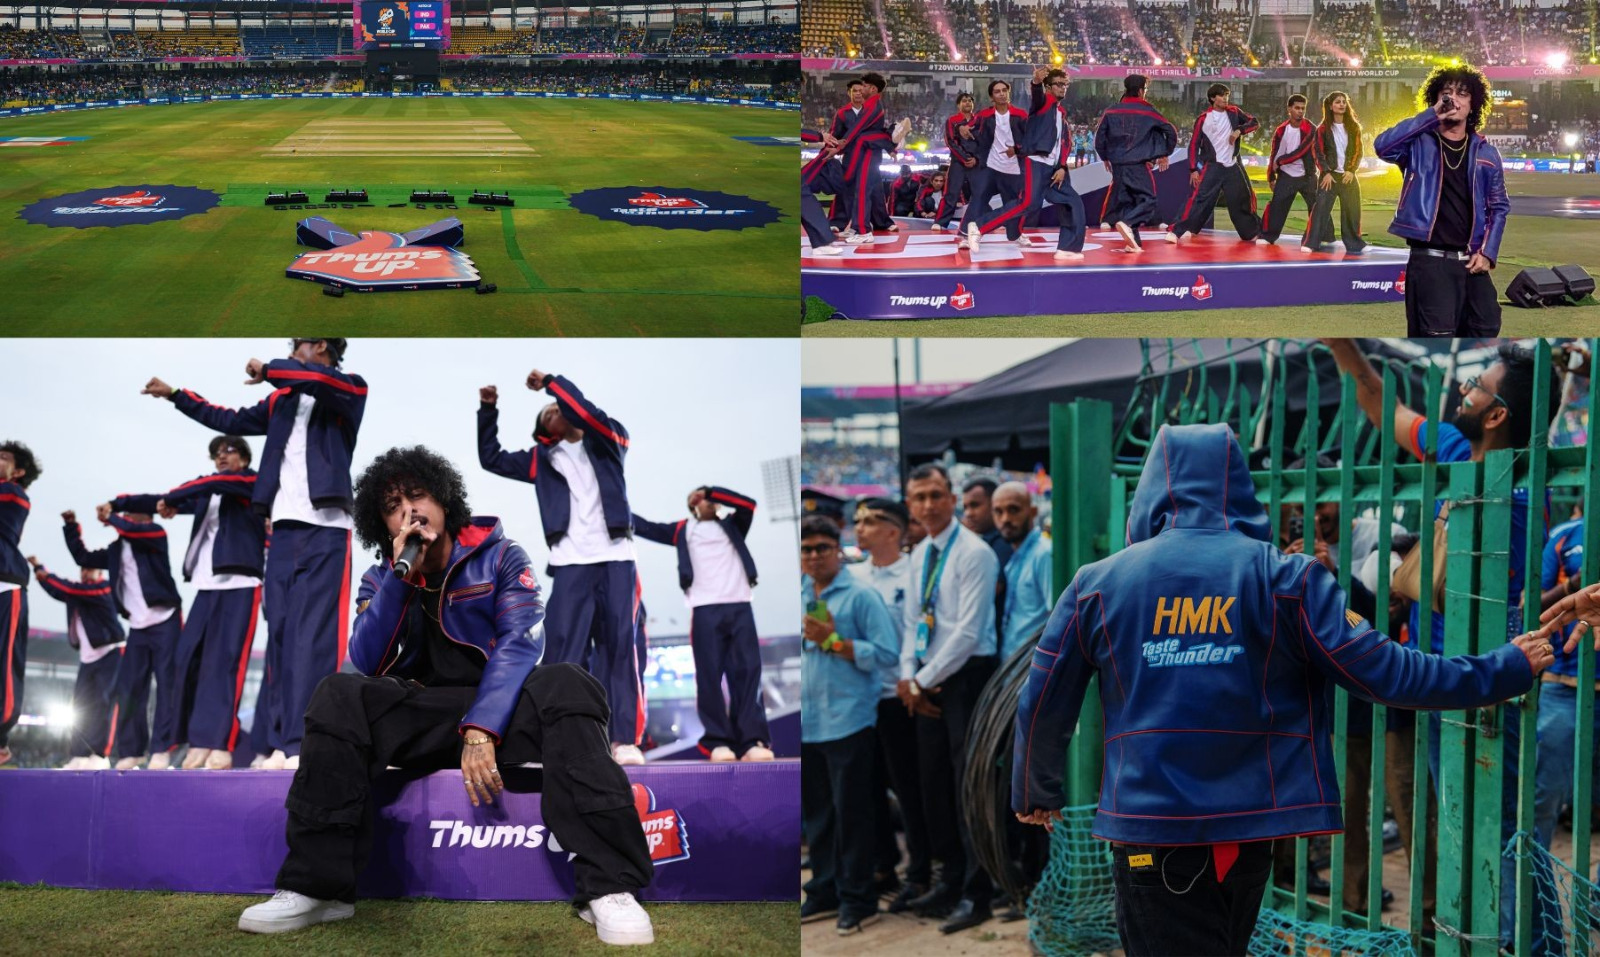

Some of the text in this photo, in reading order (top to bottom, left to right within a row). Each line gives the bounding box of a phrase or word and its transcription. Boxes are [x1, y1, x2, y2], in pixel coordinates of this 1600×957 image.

[303, 250, 443, 265] Thums
[1142, 286, 1174, 296] Thums
[1352, 281, 1380, 289] Thums
[890, 296, 930, 306] Thums
[1152, 596, 1237, 635] HMK
[1142, 638, 1180, 657] Taste
[1156, 642, 1244, 667] Thunder
[429, 820, 545, 848] Thums
